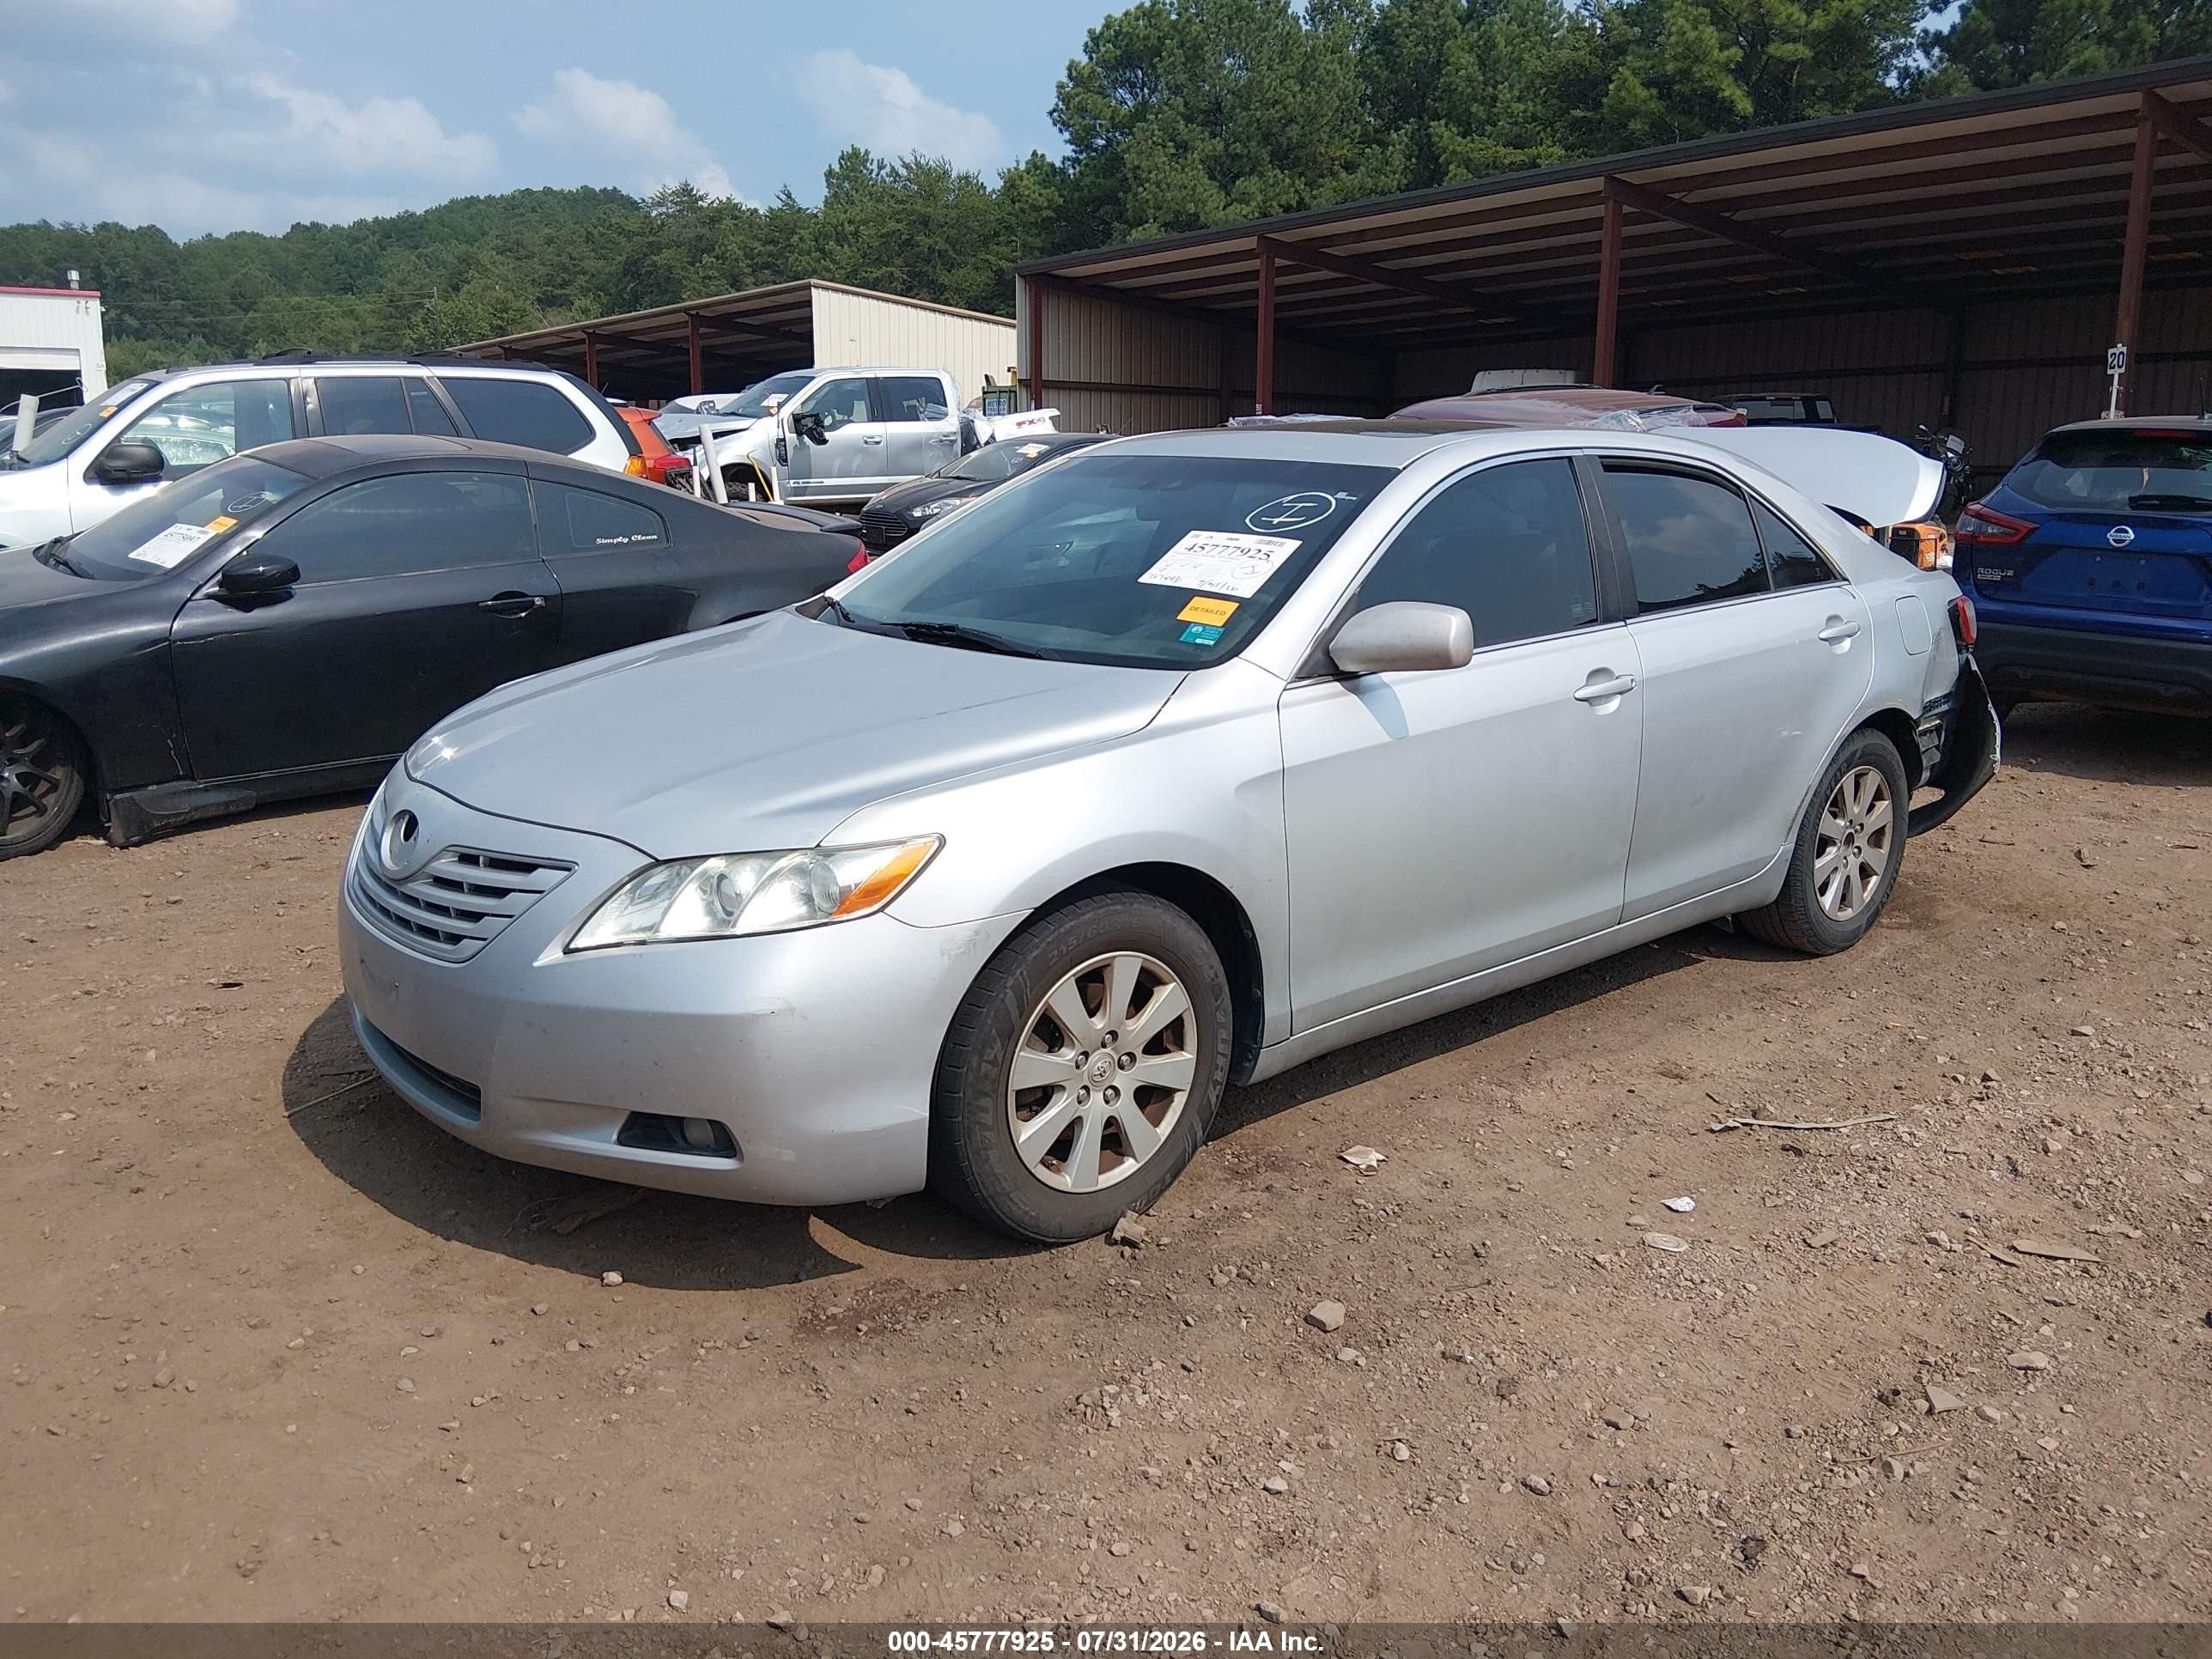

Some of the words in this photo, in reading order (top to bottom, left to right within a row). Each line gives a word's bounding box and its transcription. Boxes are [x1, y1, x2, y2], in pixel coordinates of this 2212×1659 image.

[2108, 350, 2125, 370] 20
[1184, 542, 1275, 561] 45777925
[1978, 568, 2014, 576] ROGUE
[1188, 605, 1227, 617] DETAILED
